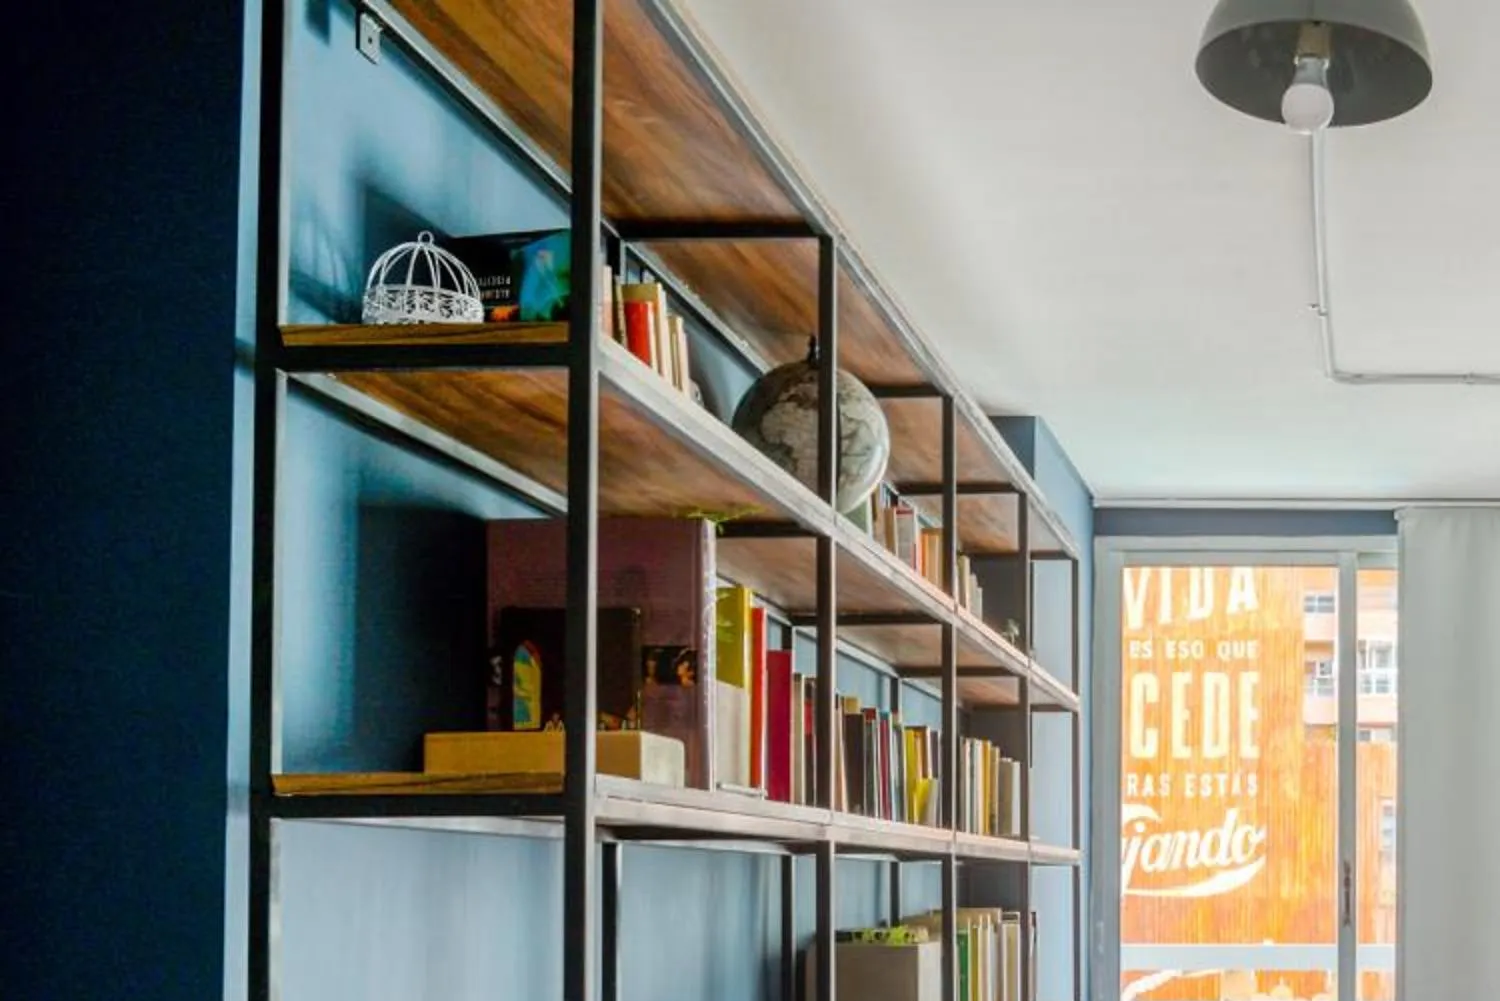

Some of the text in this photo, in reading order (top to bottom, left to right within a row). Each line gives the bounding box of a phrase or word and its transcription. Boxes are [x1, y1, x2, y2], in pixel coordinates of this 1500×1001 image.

[1123, 567, 1259, 631] VIDA
[1130, 640, 1259, 662] ES ESO QUE
[1131, 672, 1260, 758] CEDE
[1127, 773, 1170, 797] RAS
[1121, 804, 1266, 896] jando
